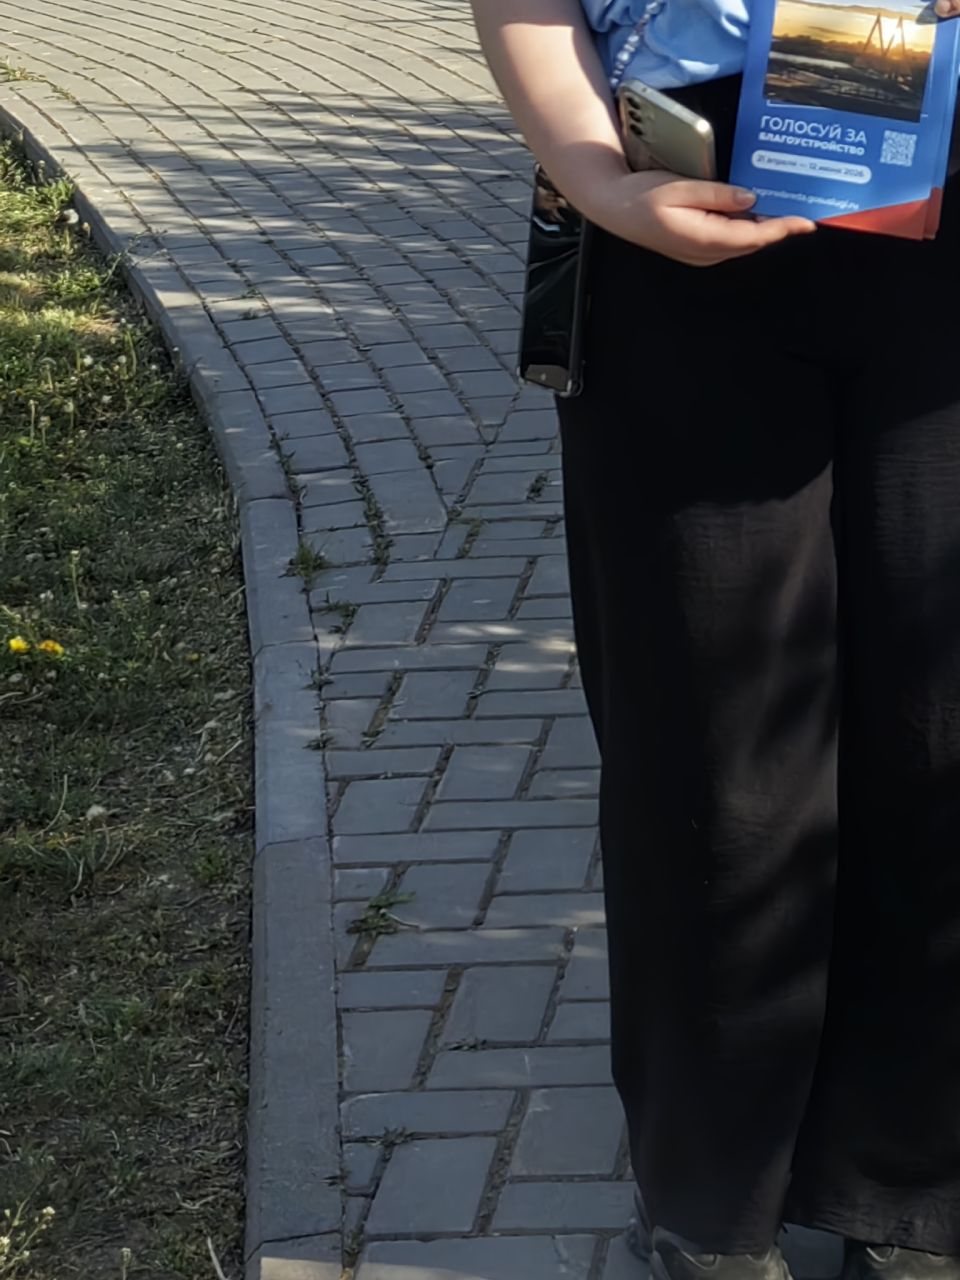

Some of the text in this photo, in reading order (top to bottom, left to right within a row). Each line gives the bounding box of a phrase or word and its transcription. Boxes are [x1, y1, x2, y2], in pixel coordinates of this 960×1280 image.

[761, 115, 867, 144] ГОЛОСУЙ ЗА
[758, 131, 865, 156] БЛАГОУСТРОЙСТВО
